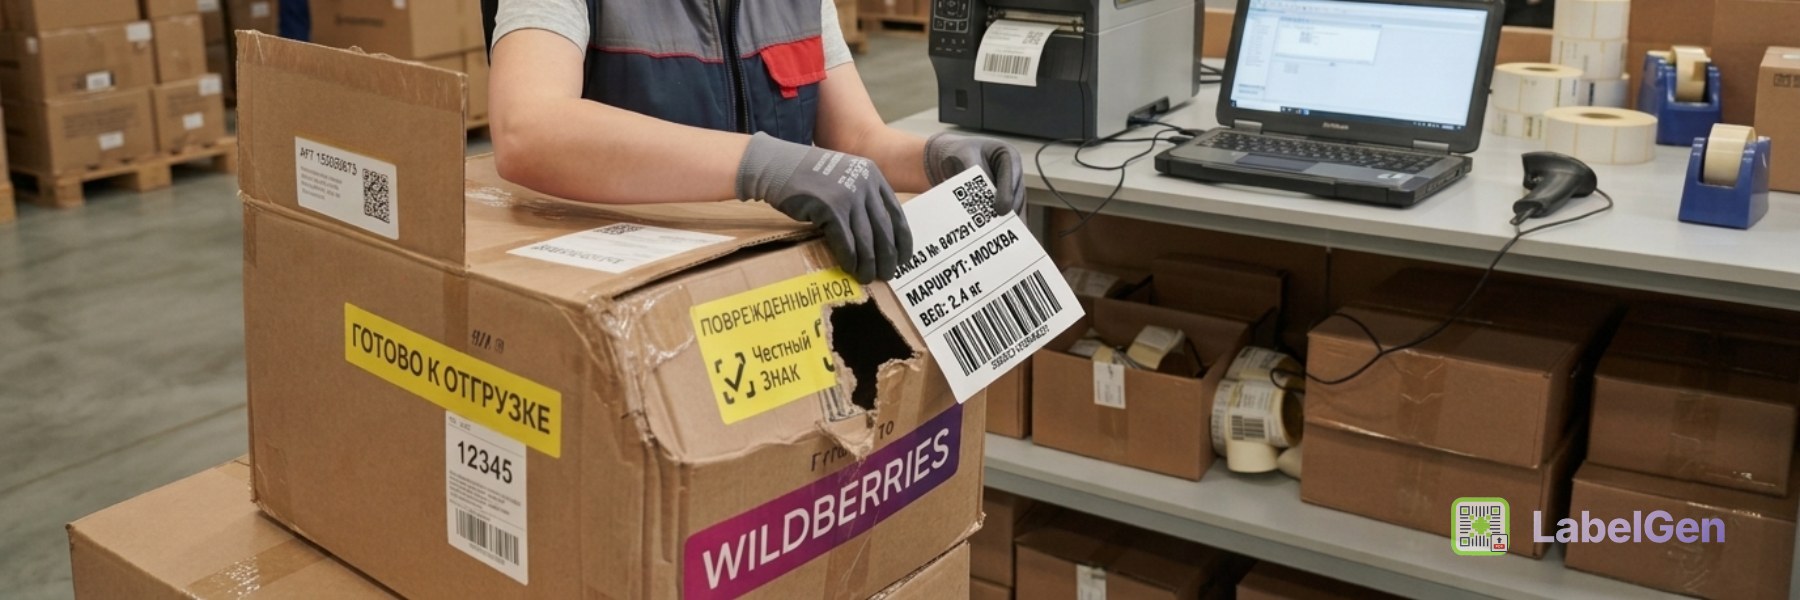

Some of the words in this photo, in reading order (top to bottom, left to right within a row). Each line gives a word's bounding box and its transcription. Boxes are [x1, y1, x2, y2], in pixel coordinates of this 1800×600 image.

[969, 229, 1019, 267] МОСКВА
[700, 282, 823, 336] ПОВРЕЖДЕННЫЙ
[822, 278, 855, 301] КОД
[752, 329, 812, 364] Честный
[352, 322, 423, 377] ГОТОВО
[428, 356, 440, 387] К
[444, 366, 550, 435] ОТГРУЗКЕ
[760, 364, 801, 391] ЗНАК
[457, 440, 513, 484] 12345
[702, 427, 950, 590] WILDBERRIES
